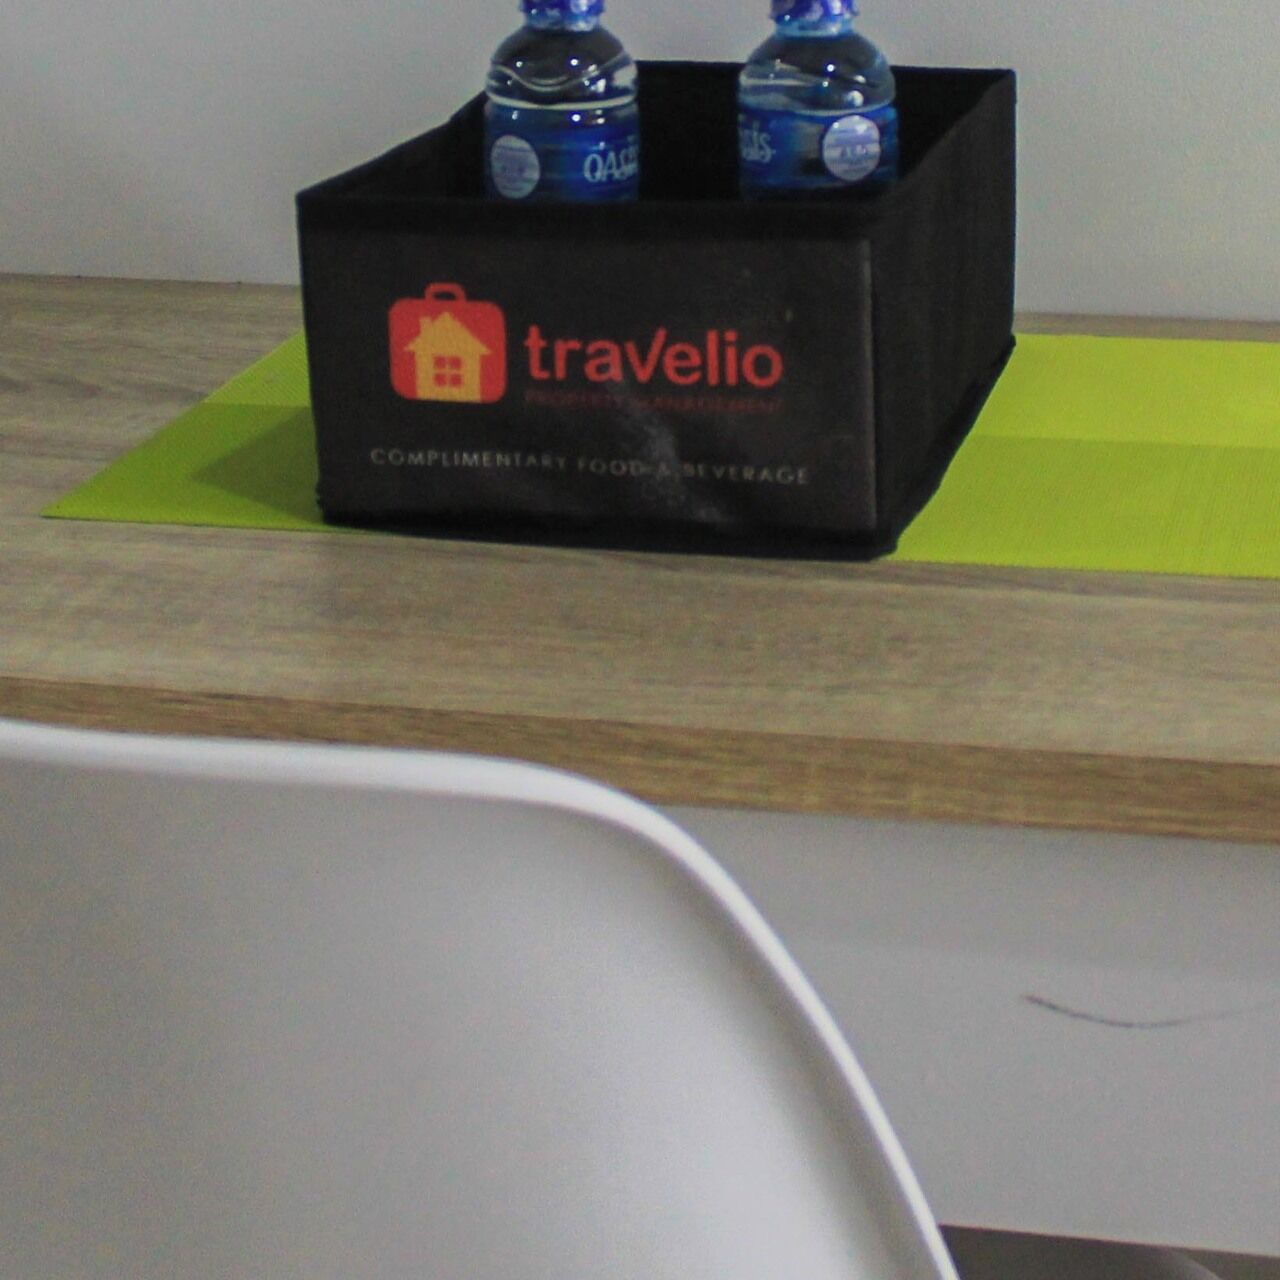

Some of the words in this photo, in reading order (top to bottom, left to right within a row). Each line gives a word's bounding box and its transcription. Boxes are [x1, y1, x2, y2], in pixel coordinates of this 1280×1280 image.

[524, 323, 784, 388] travelio
[370, 447, 566, 470] COMPLIMENTARY
[577, 456, 642, 477] FOOD
[682, 462, 808, 485] BEVERAGE
